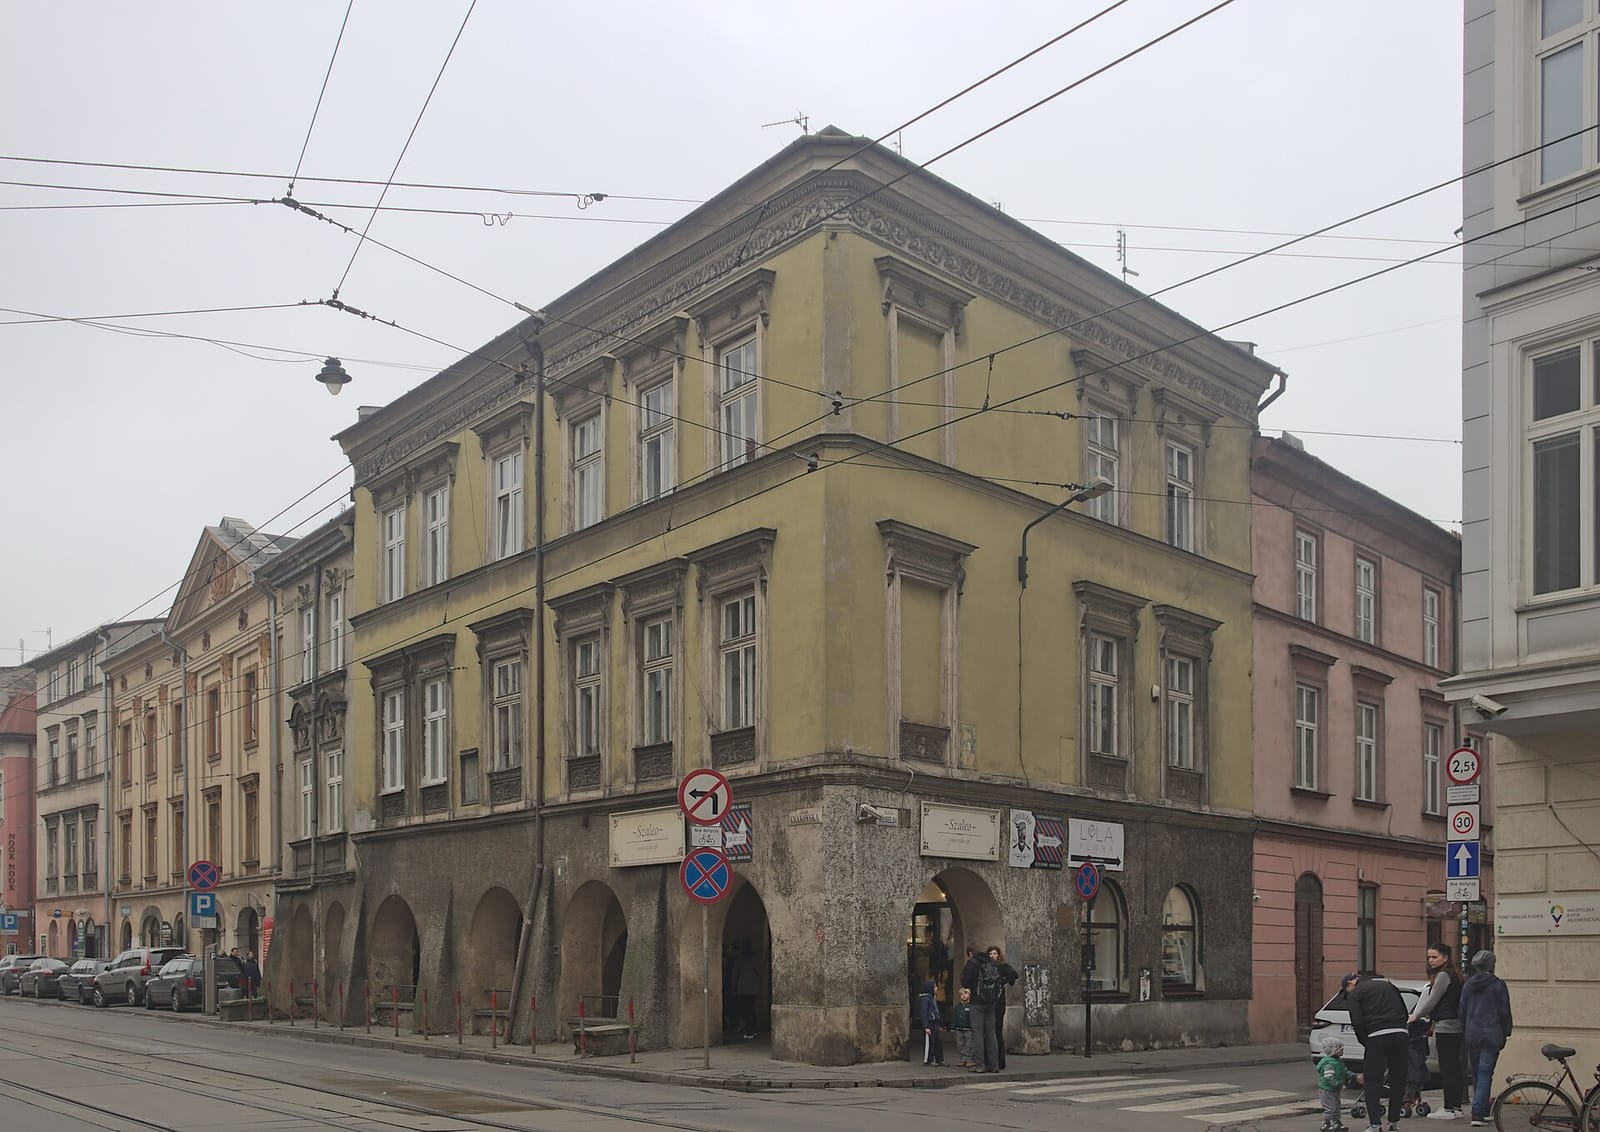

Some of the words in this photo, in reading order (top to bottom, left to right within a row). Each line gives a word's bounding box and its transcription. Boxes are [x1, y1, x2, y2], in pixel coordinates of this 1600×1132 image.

[1453, 760, 1475, 773] 2,5t
[1456, 817, 1470, 828] 30
[1080, 823, 1113, 842] LOLA
[8, 833, 16, 860] NOOK
[8, 863, 16, 891] NOOK
[196, 895, 211, 914] P
[4, 915, 15, 928] P
